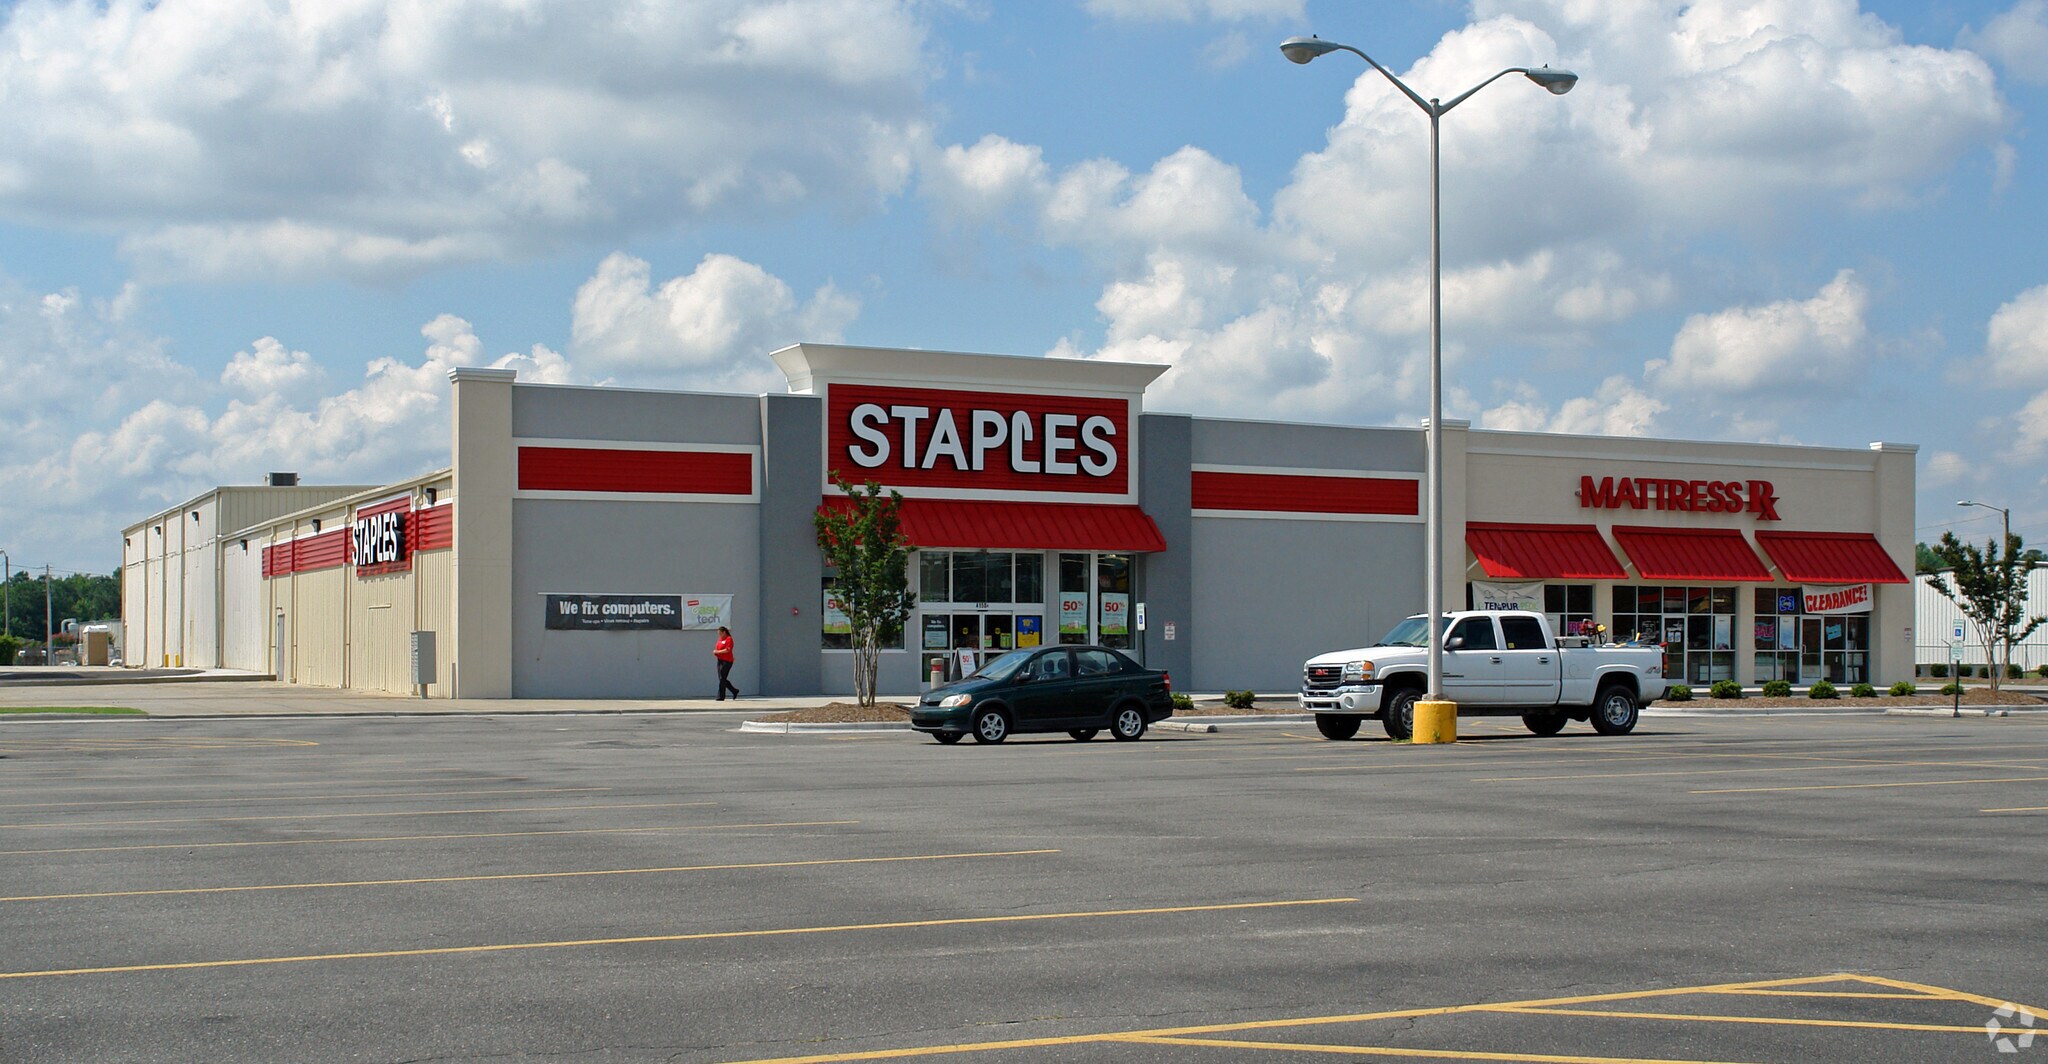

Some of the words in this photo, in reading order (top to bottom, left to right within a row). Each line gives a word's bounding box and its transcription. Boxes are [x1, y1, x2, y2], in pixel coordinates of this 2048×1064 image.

[848, 403, 1118, 477] STAPLES
[1580, 475, 1743, 513] MATTRESS
[352, 512, 398, 566] STAPLES
[559, 601, 578, 615] We
[582, 601, 599, 615] fix
[601, 602, 675, 617] computers.
[691, 605, 719, 618] easy
[1805, 585, 1868, 612] CLEARANCE!
[697, 614, 721, 624] tech
